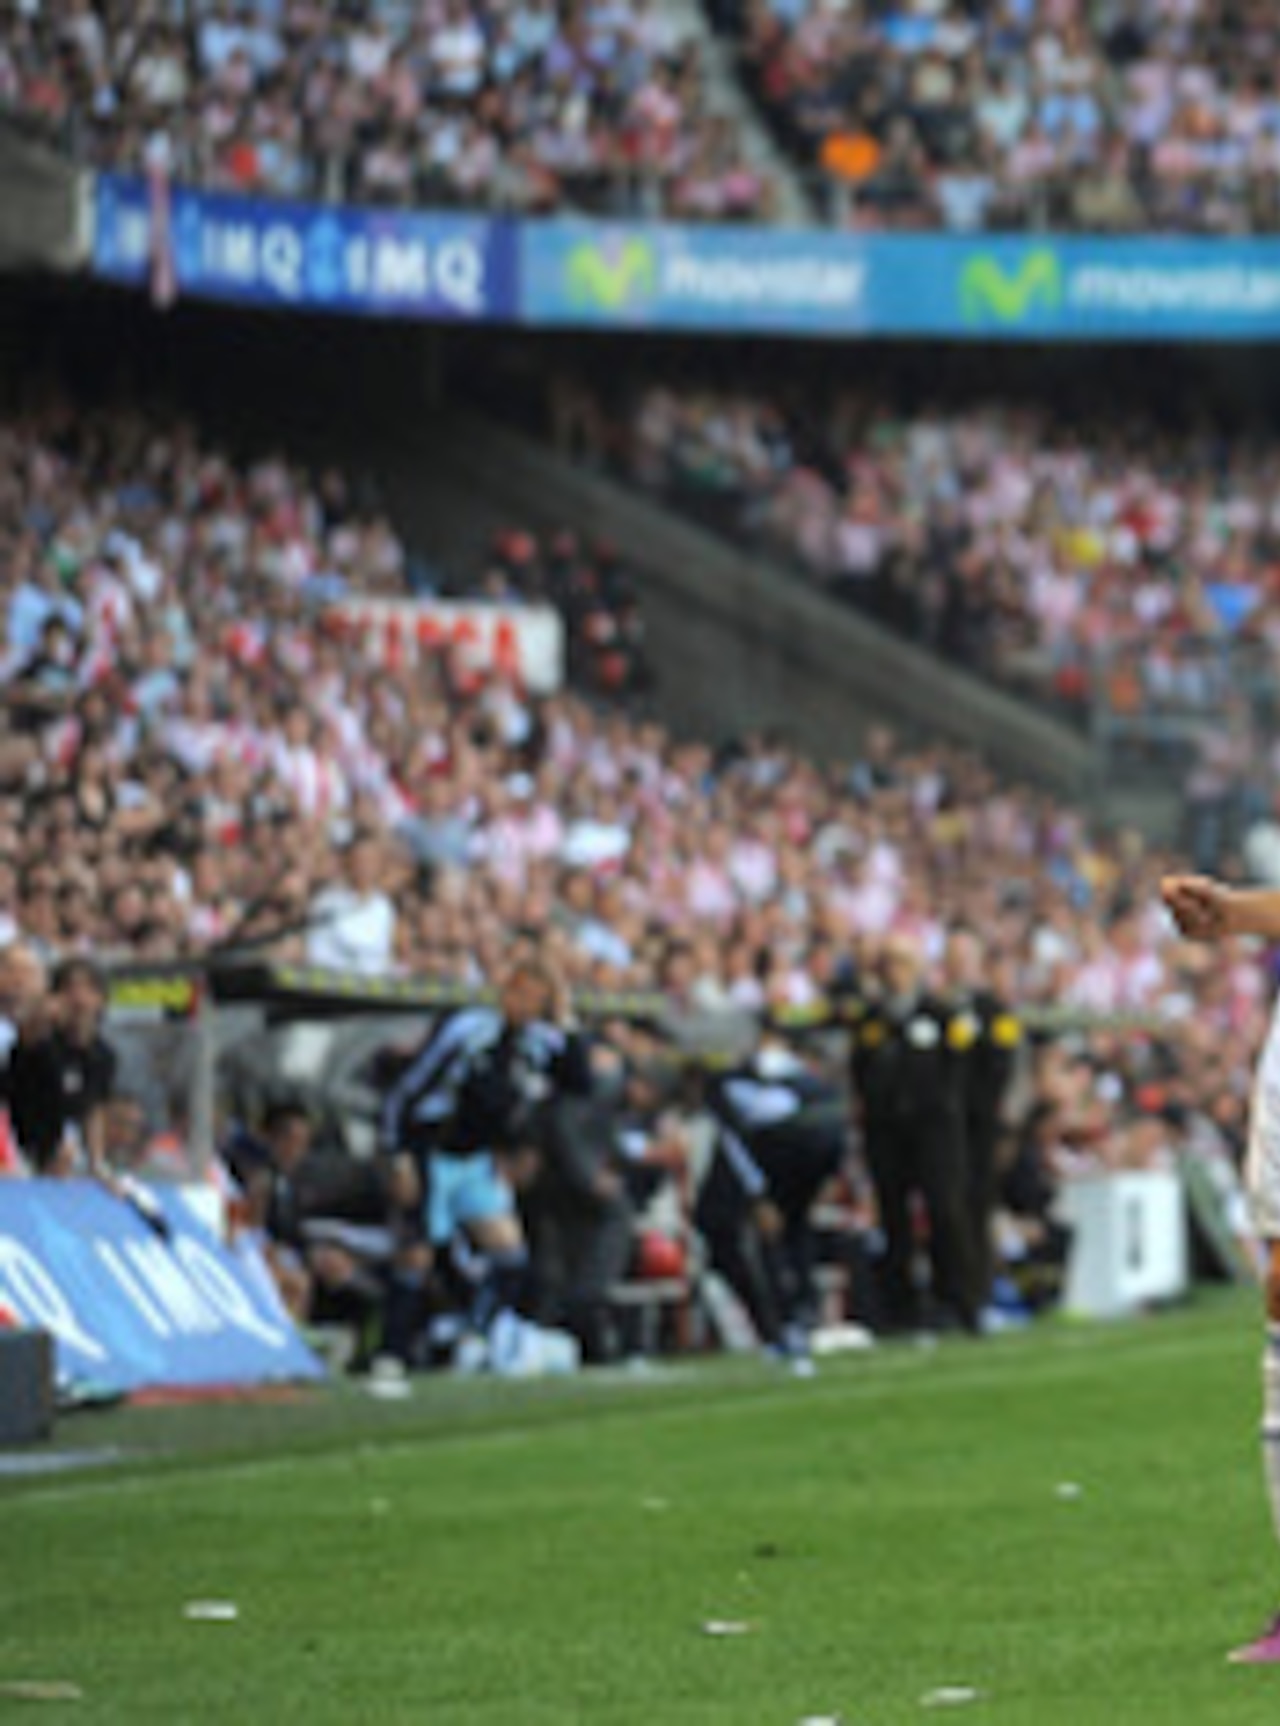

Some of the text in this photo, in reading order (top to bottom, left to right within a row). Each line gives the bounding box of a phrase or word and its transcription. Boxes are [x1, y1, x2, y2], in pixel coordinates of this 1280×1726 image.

[202, 220, 301, 297] IMQ
[345, 238, 486, 313] IMQ
[661, 252, 867, 306] movistar
[94, 1232, 288, 1348] IMQ
